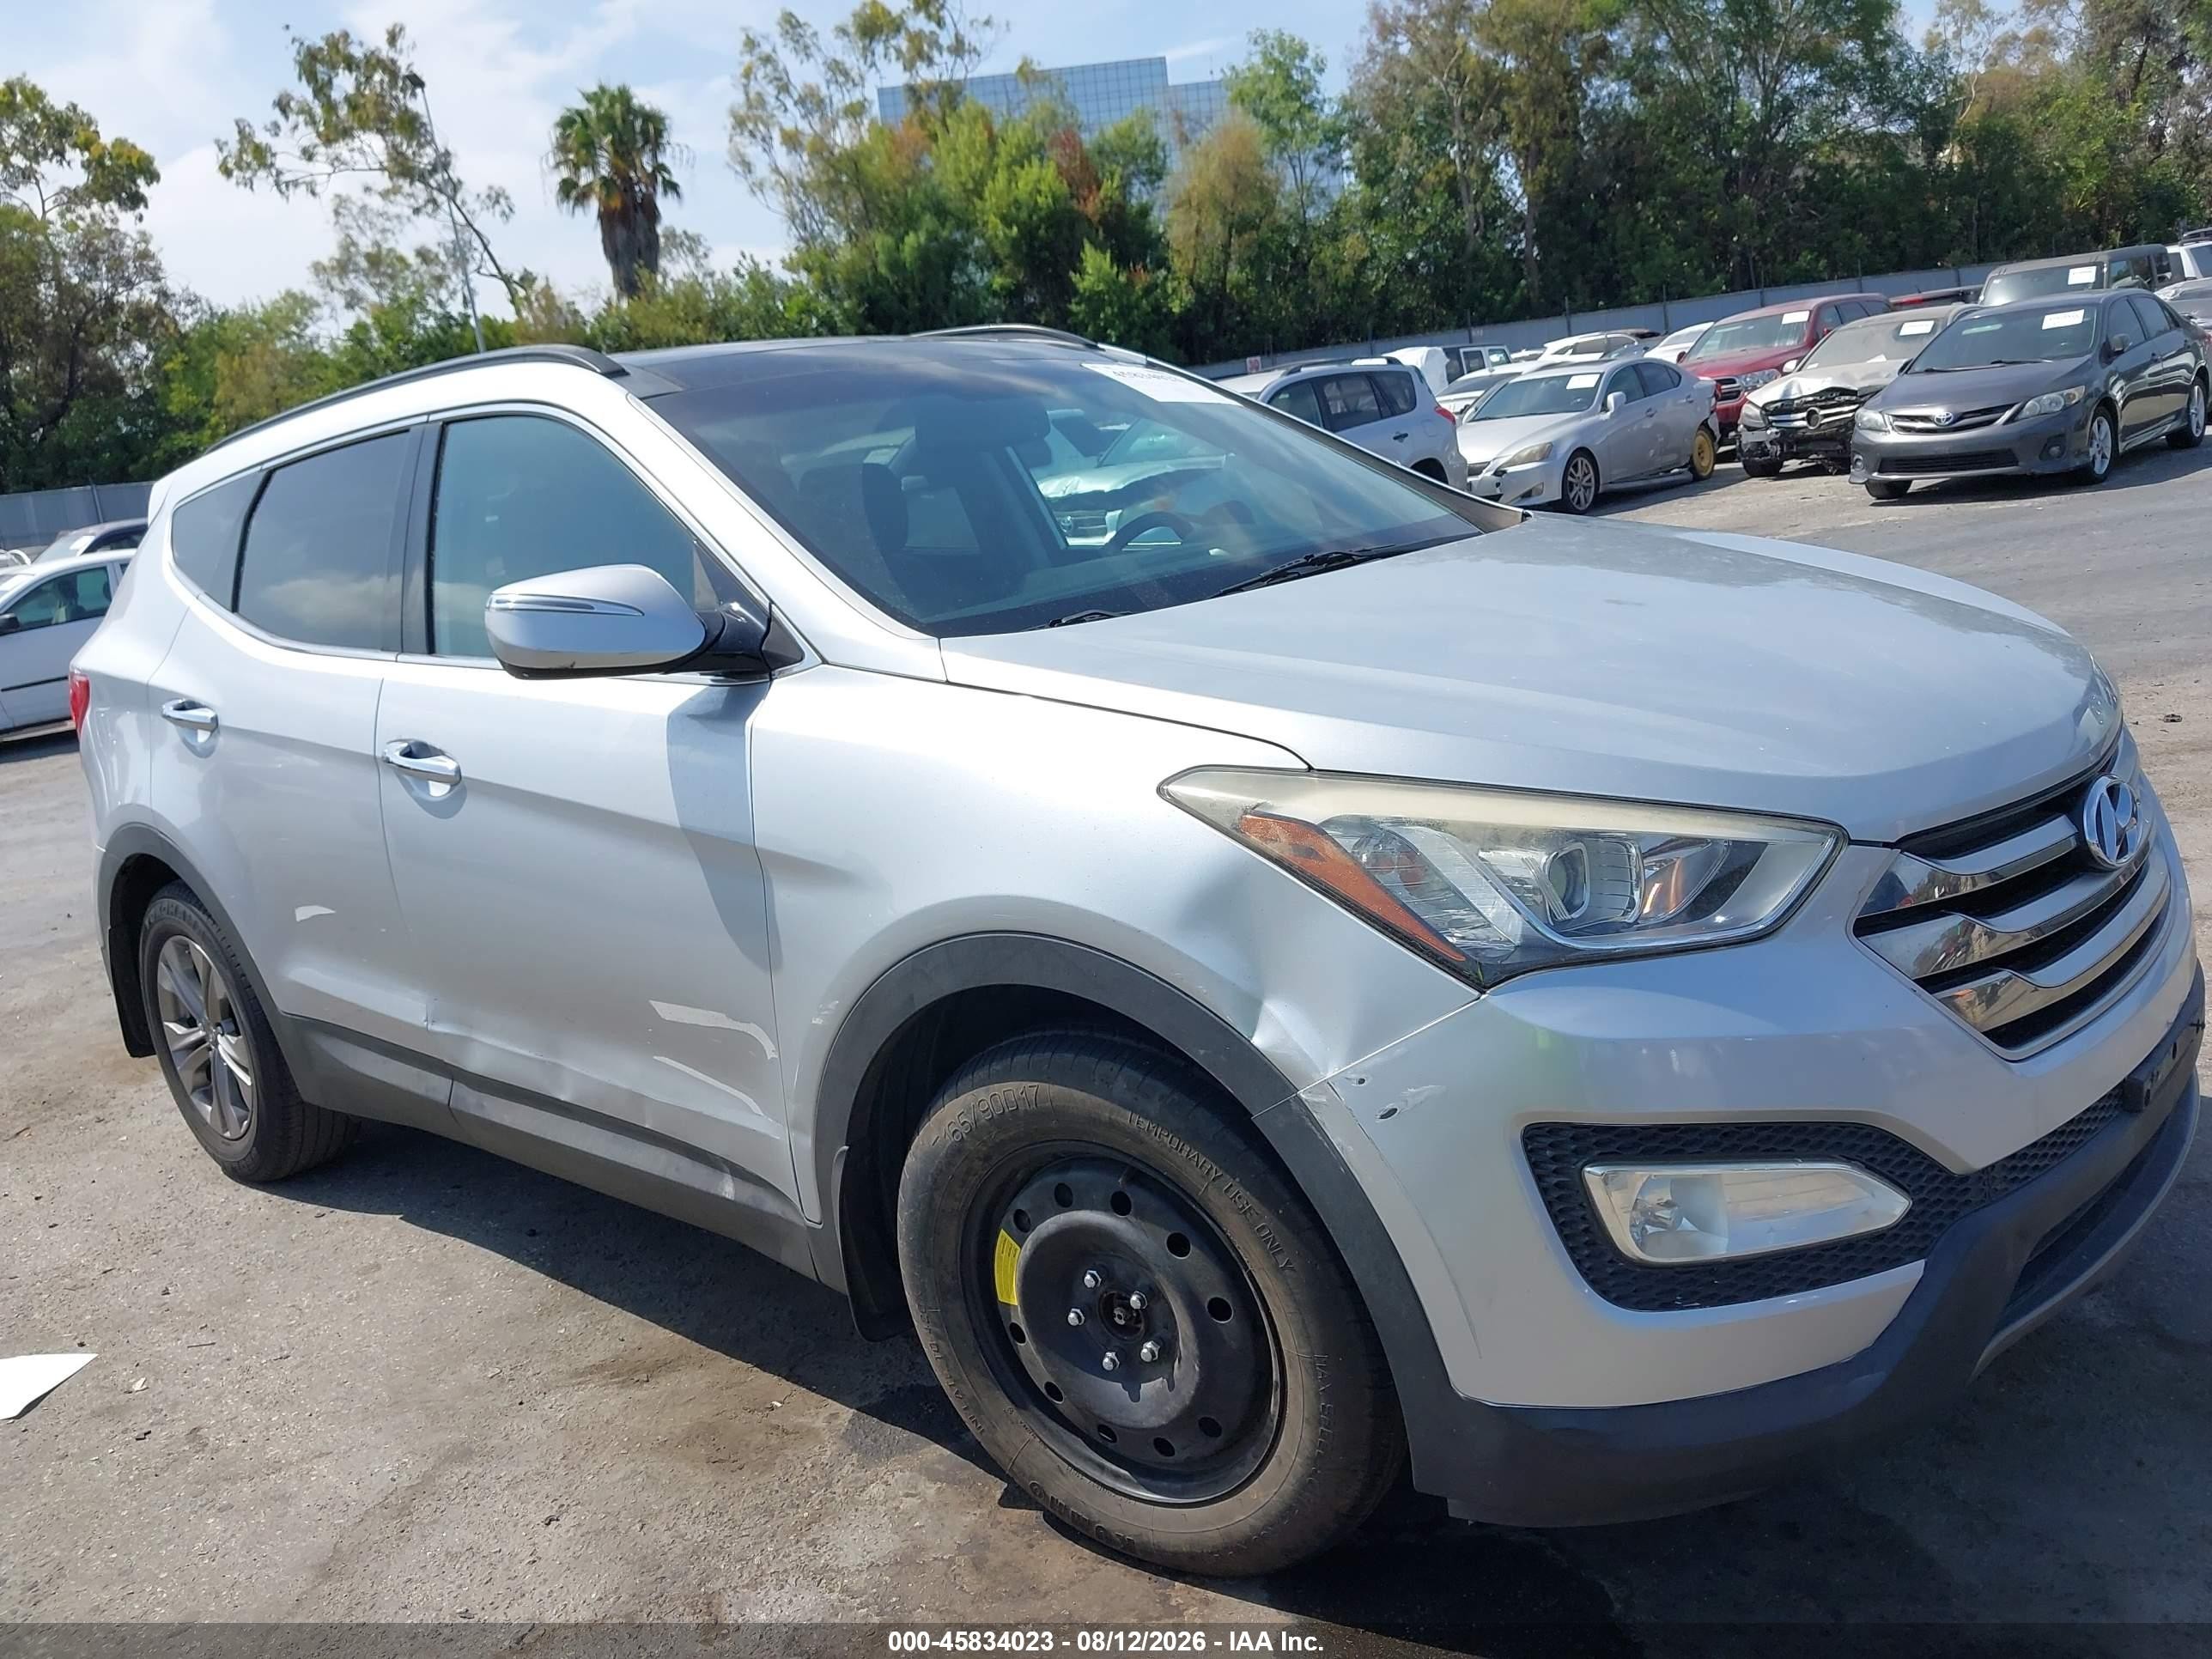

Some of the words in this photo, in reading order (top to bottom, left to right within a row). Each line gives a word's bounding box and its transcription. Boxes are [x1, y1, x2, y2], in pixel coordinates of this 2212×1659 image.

[1127, 1110, 1224, 1182] TEMPORARY
[1222, 1181, 1261, 1222] USE
[1255, 1221, 1297, 1273] ONLY
